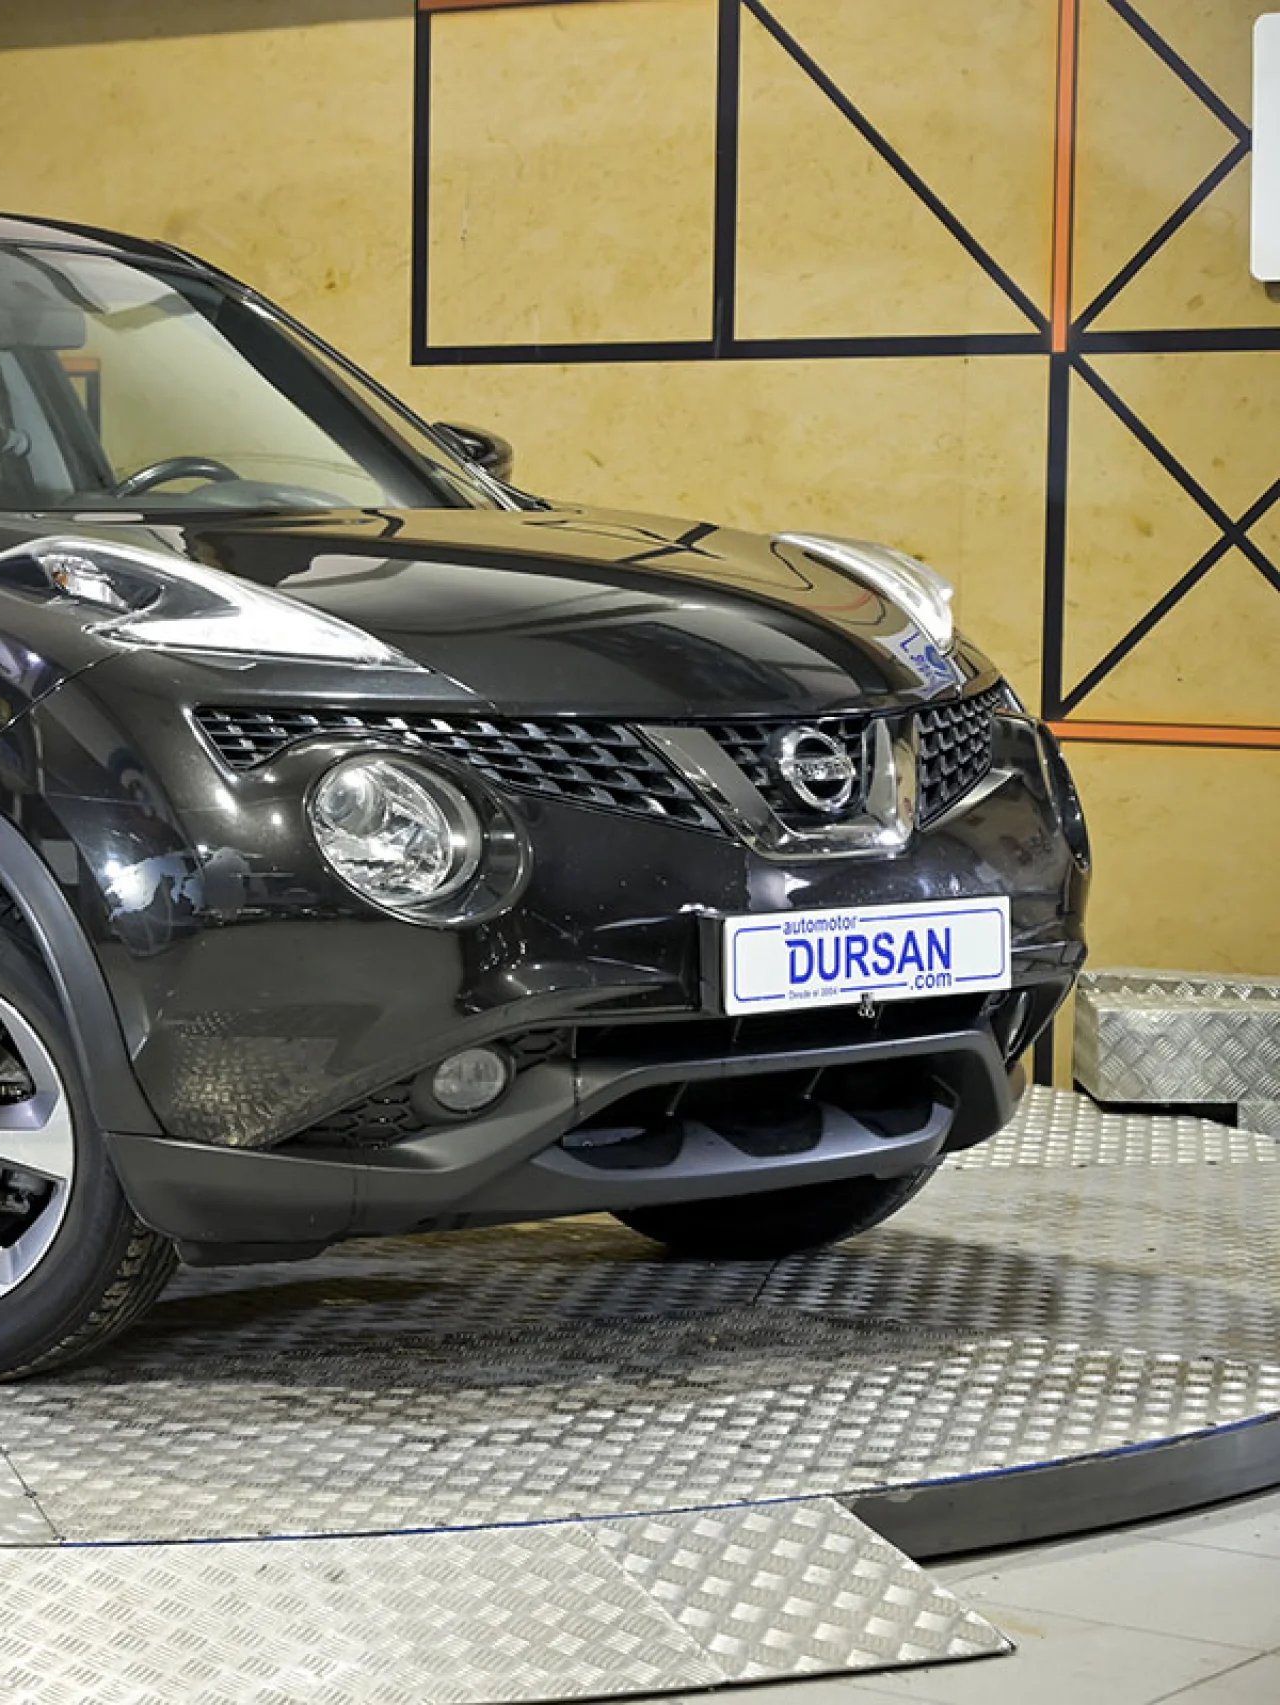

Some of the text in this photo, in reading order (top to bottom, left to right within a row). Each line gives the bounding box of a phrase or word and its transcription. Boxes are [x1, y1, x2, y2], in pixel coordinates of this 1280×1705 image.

[782, 915, 857, 935] automotor
[784, 926, 952, 984] DURSAN
[909, 972, 953, 991] .com
